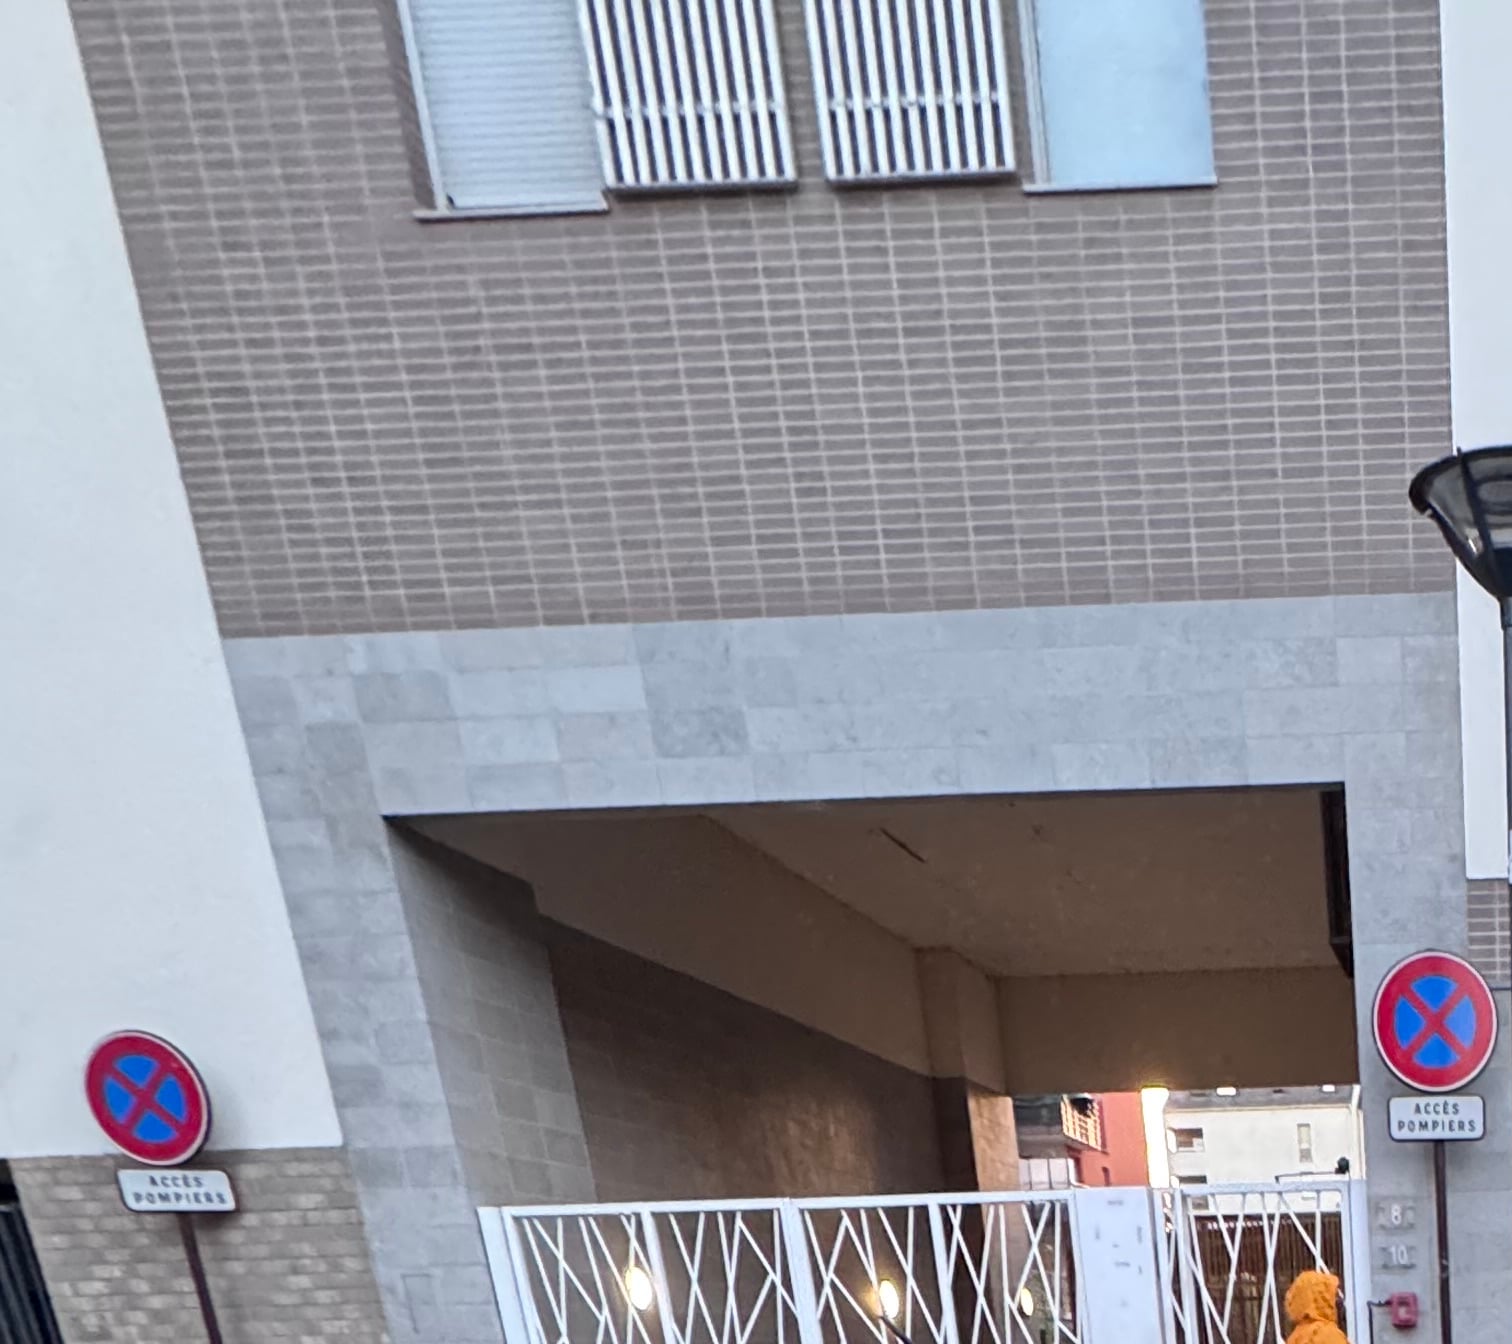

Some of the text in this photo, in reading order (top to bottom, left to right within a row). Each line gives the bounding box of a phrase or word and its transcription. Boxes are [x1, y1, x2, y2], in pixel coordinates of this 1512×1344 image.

[1414, 1100, 1460, 1115] ACCÈS
[1397, 1119, 1476, 1133] POMPIERS
[149, 1173, 203, 1188] ACCÈS
[132, 1192, 228, 1205] POMPIERS
